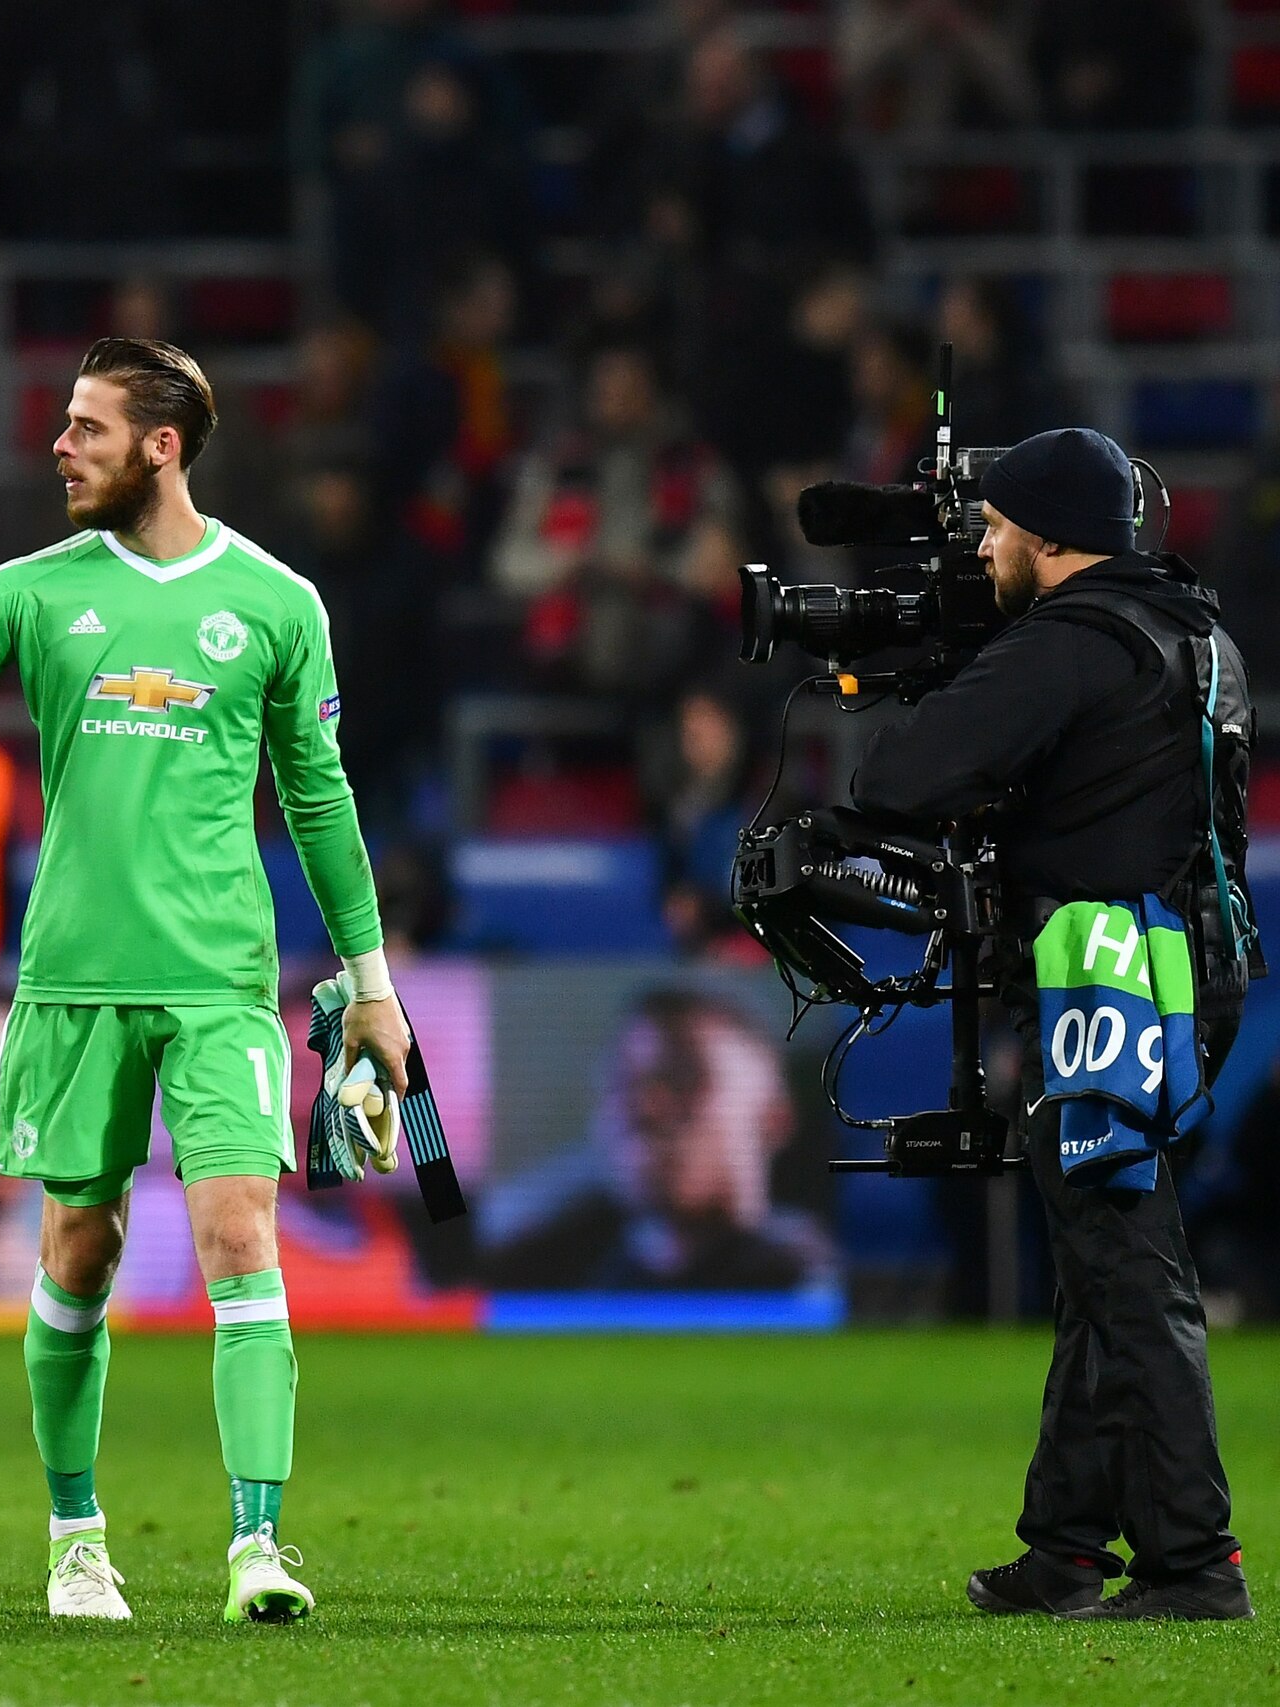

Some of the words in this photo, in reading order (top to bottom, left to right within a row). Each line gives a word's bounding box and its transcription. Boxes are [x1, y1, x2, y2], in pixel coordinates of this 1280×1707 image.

[68, 624, 107, 634] adidas
[205, 646, 236, 660] UNITED
[81, 719, 209, 744] CHEVROLET
[880, 842, 914, 859] STEADICAM
[246, 1047, 273, 1117] 1
[905, 1140, 942, 1148] STEADICAM
